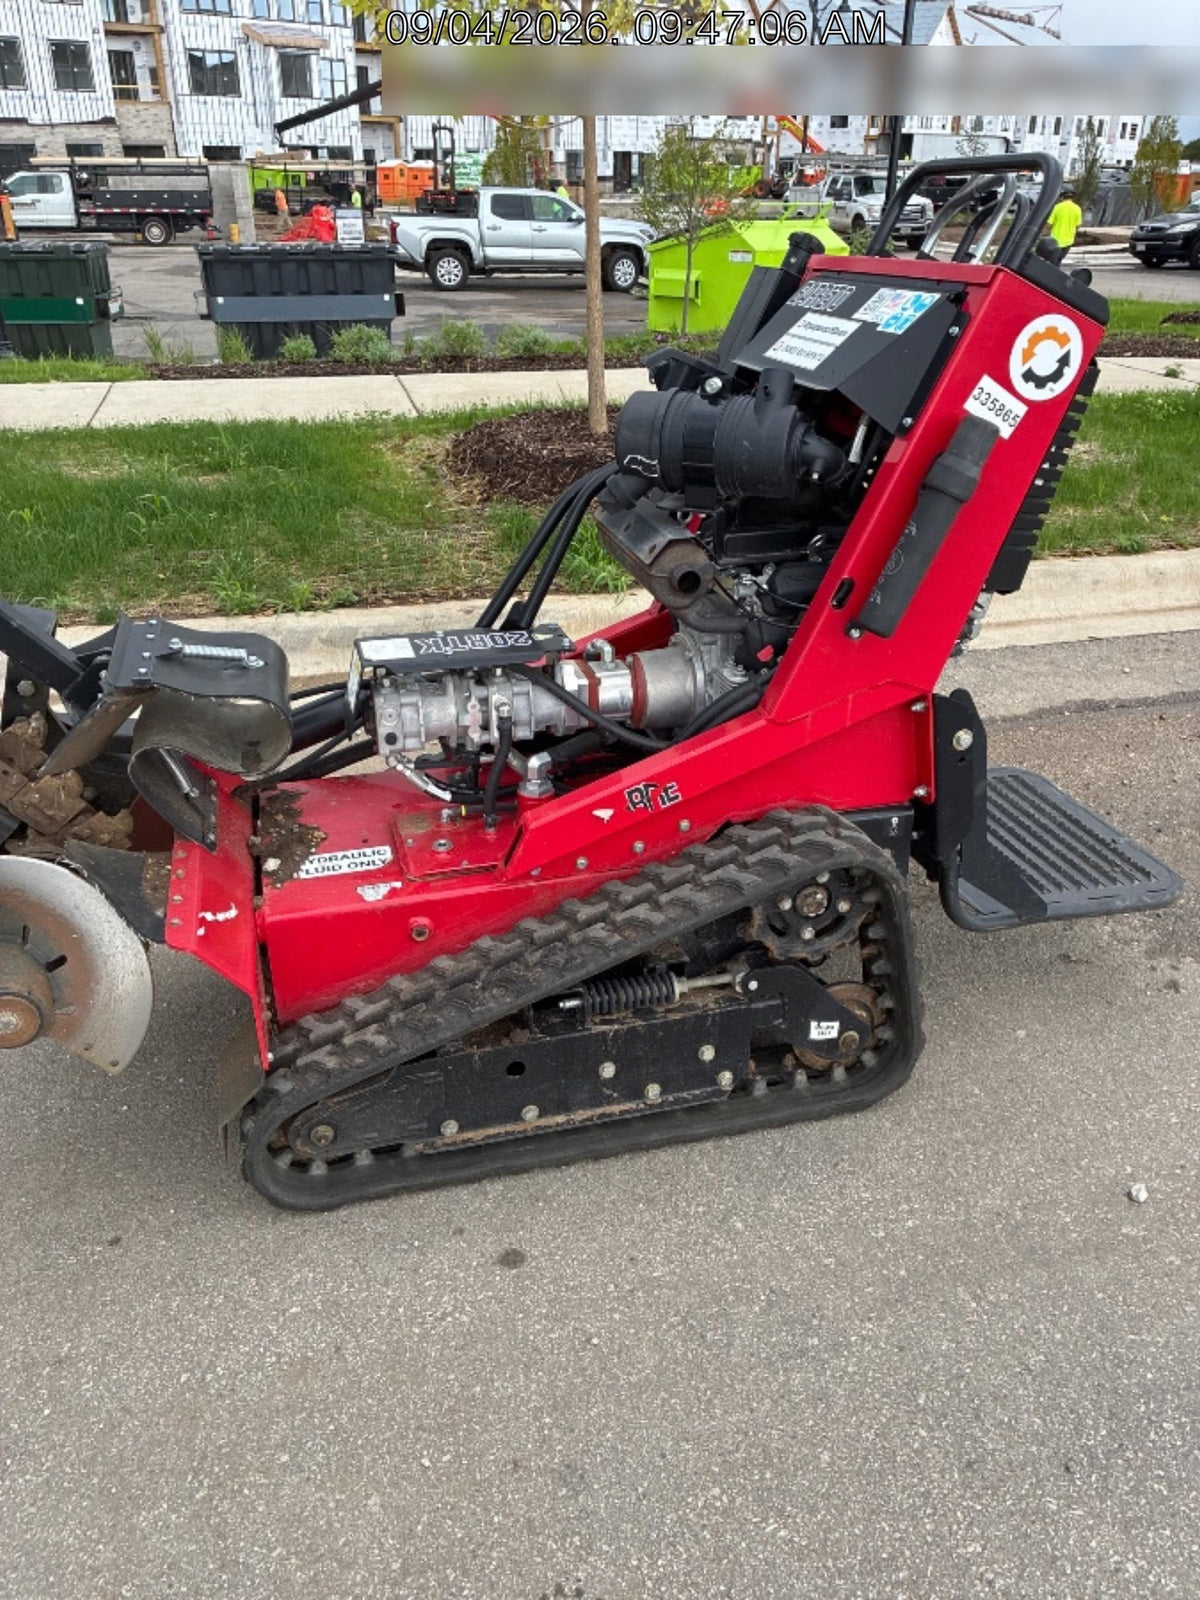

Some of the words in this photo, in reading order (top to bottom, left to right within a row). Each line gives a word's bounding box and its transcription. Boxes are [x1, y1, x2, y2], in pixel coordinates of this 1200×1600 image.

[972, 386, 1021, 428] 335865
[306, 848, 388, 865] YDRAULIC
[300, 865, 342, 876] LUID
[347, 857, 389, 869] ONLY
